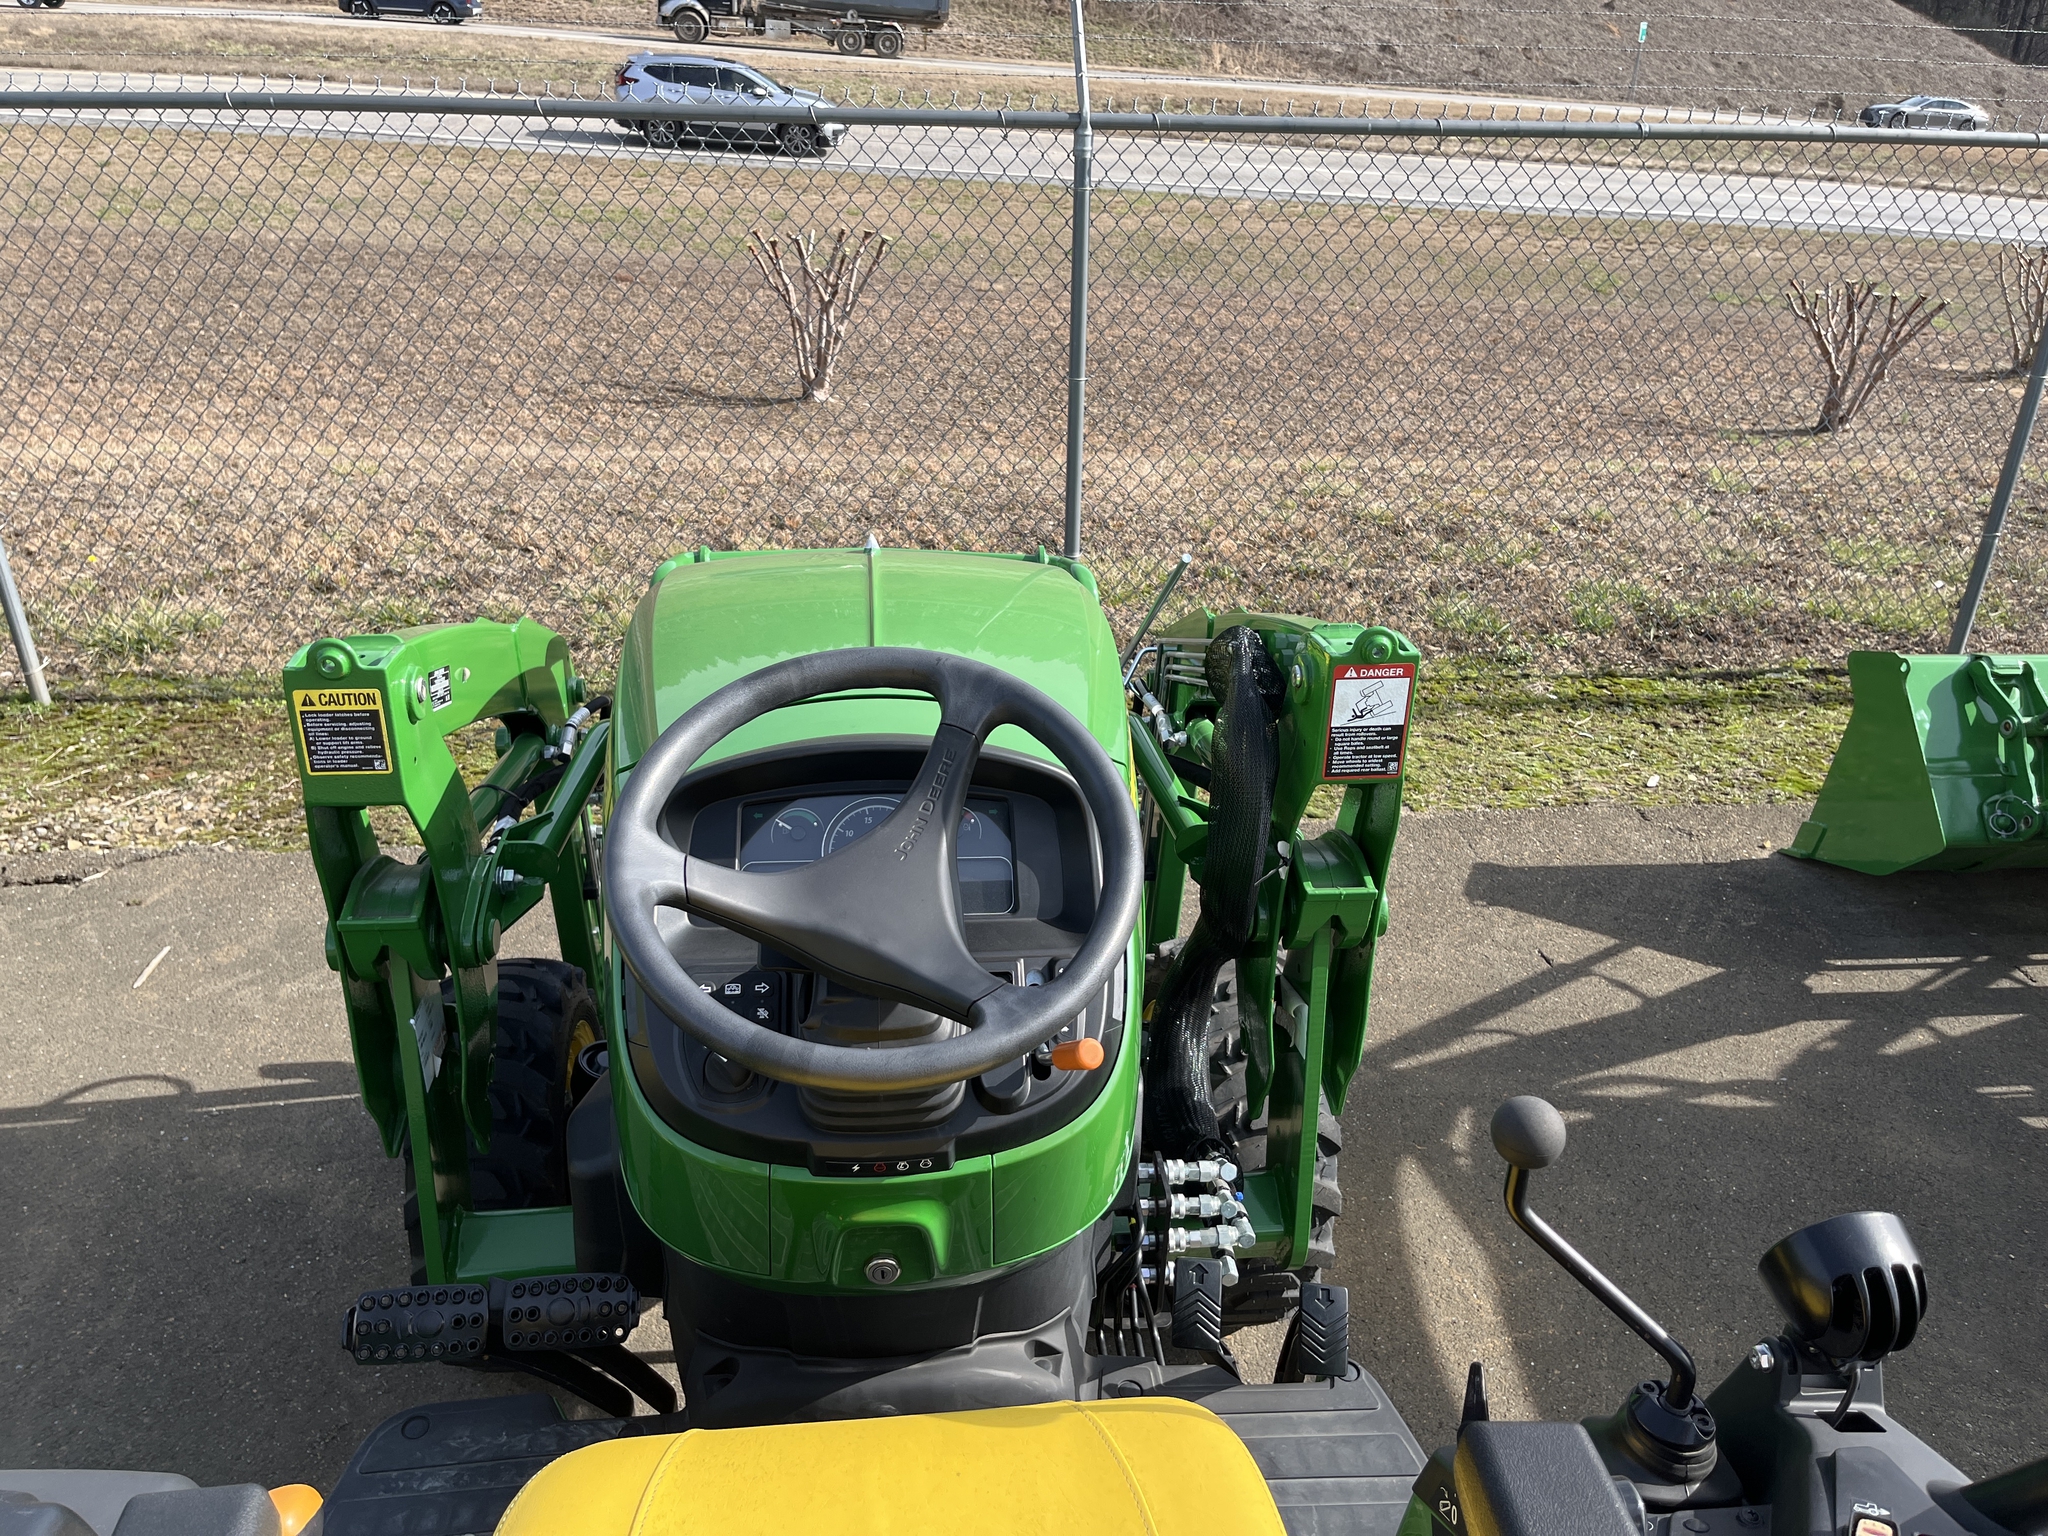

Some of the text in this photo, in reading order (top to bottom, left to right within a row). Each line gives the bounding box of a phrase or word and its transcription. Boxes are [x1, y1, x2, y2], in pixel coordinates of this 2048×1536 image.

[1360, 668, 1404, 677] DANGER
[318, 693, 377, 706] CAUTION
[894, 748, 957, 861] JOHN DEERE
